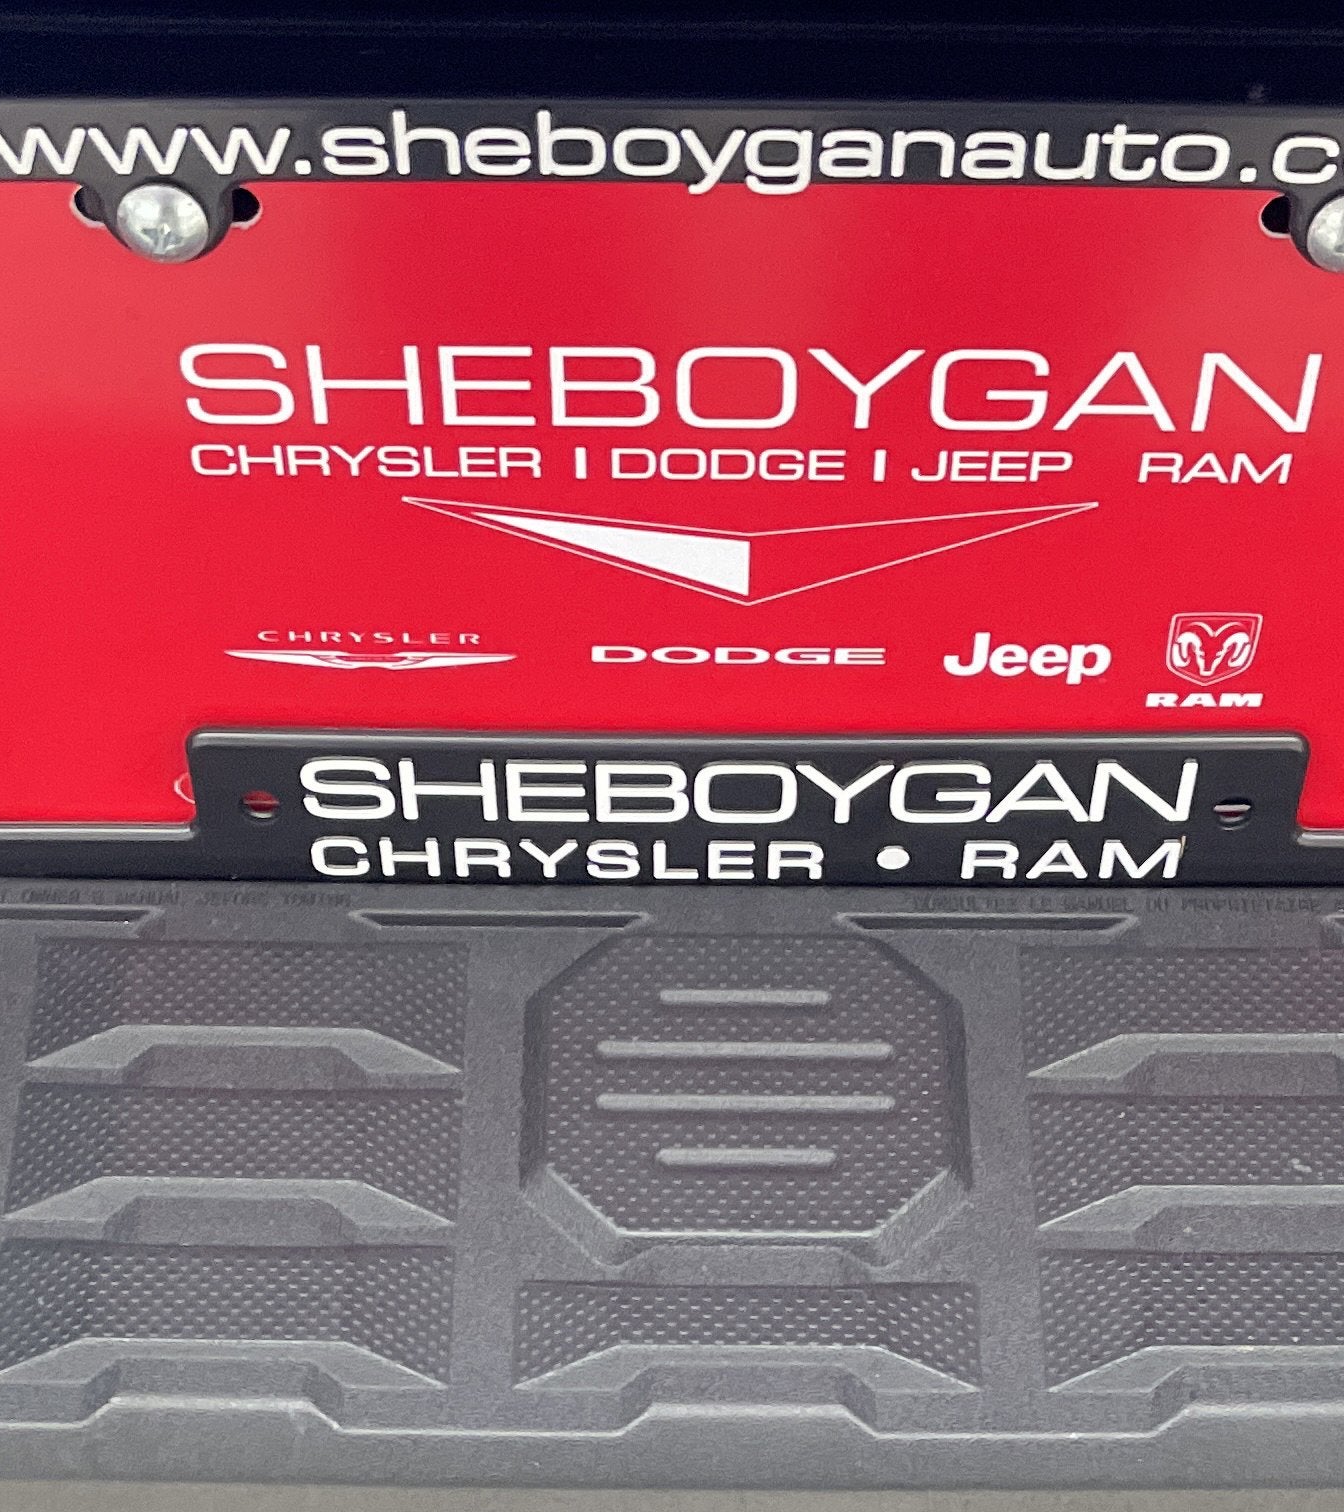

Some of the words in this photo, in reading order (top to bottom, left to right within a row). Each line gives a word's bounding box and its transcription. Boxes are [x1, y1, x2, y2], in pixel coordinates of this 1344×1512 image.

[179, 343, 1323, 433] SHEBOYGAN
[190, 444, 541, 478] CHRYSLER
[611, 447, 846, 481] DODGE
[911, 450, 1073, 482] JEEP
[1138, 452, 1293, 484] RAM
[257, 630, 482, 646] CHRYSLER
[591, 645, 886, 665] DODGE
[943, 632, 1112, 685] Jeep
[1145, 692, 1263, 708] RAM
[299, 755, 1199, 825] SHEBOYGAN
[310, 836, 825, 880] CHRYSLER
[960, 839, 1183, 880] RAM
